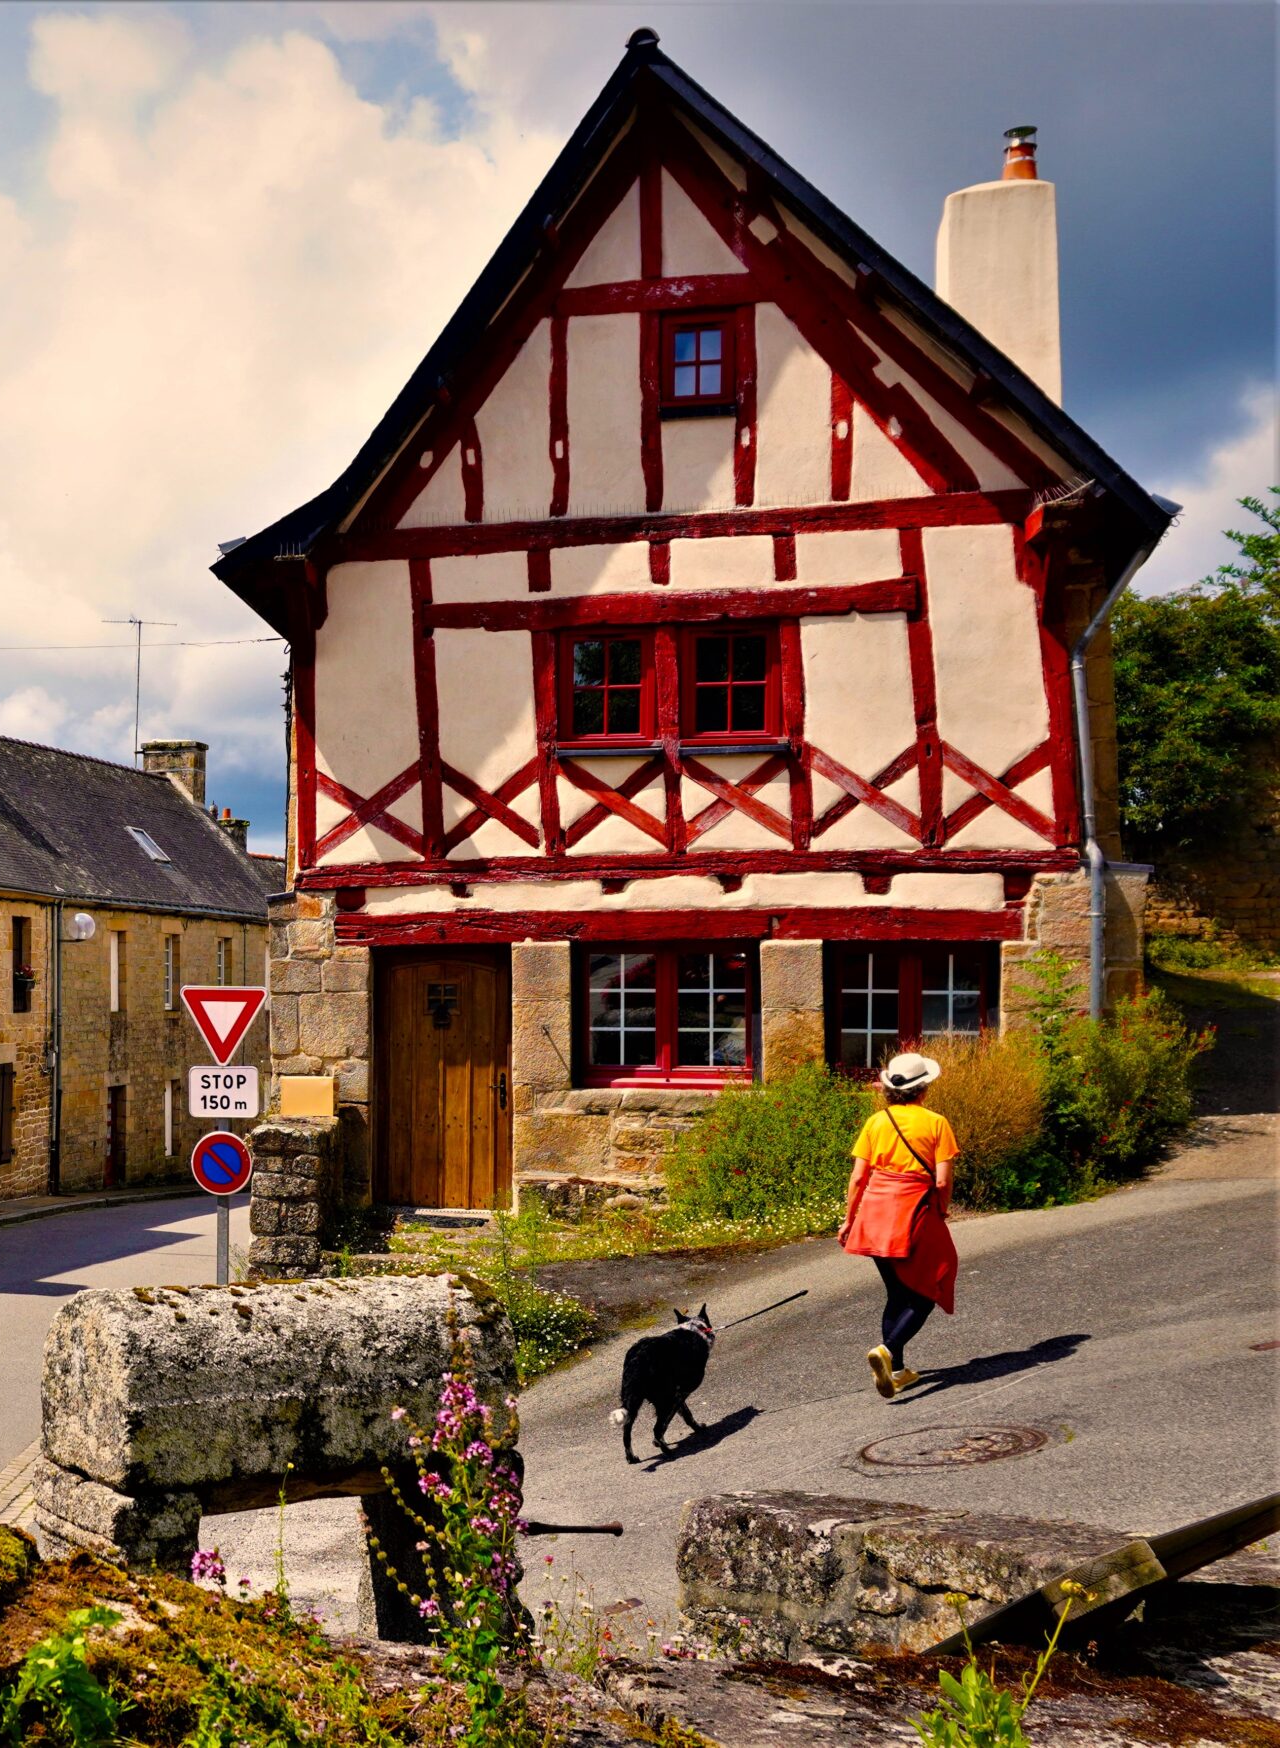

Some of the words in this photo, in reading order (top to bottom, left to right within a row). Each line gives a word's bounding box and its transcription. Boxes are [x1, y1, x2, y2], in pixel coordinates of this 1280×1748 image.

[201, 1074, 247, 1089] STOP
[201, 1095, 230, 1110] 150
[235, 1101, 247, 1110] m
